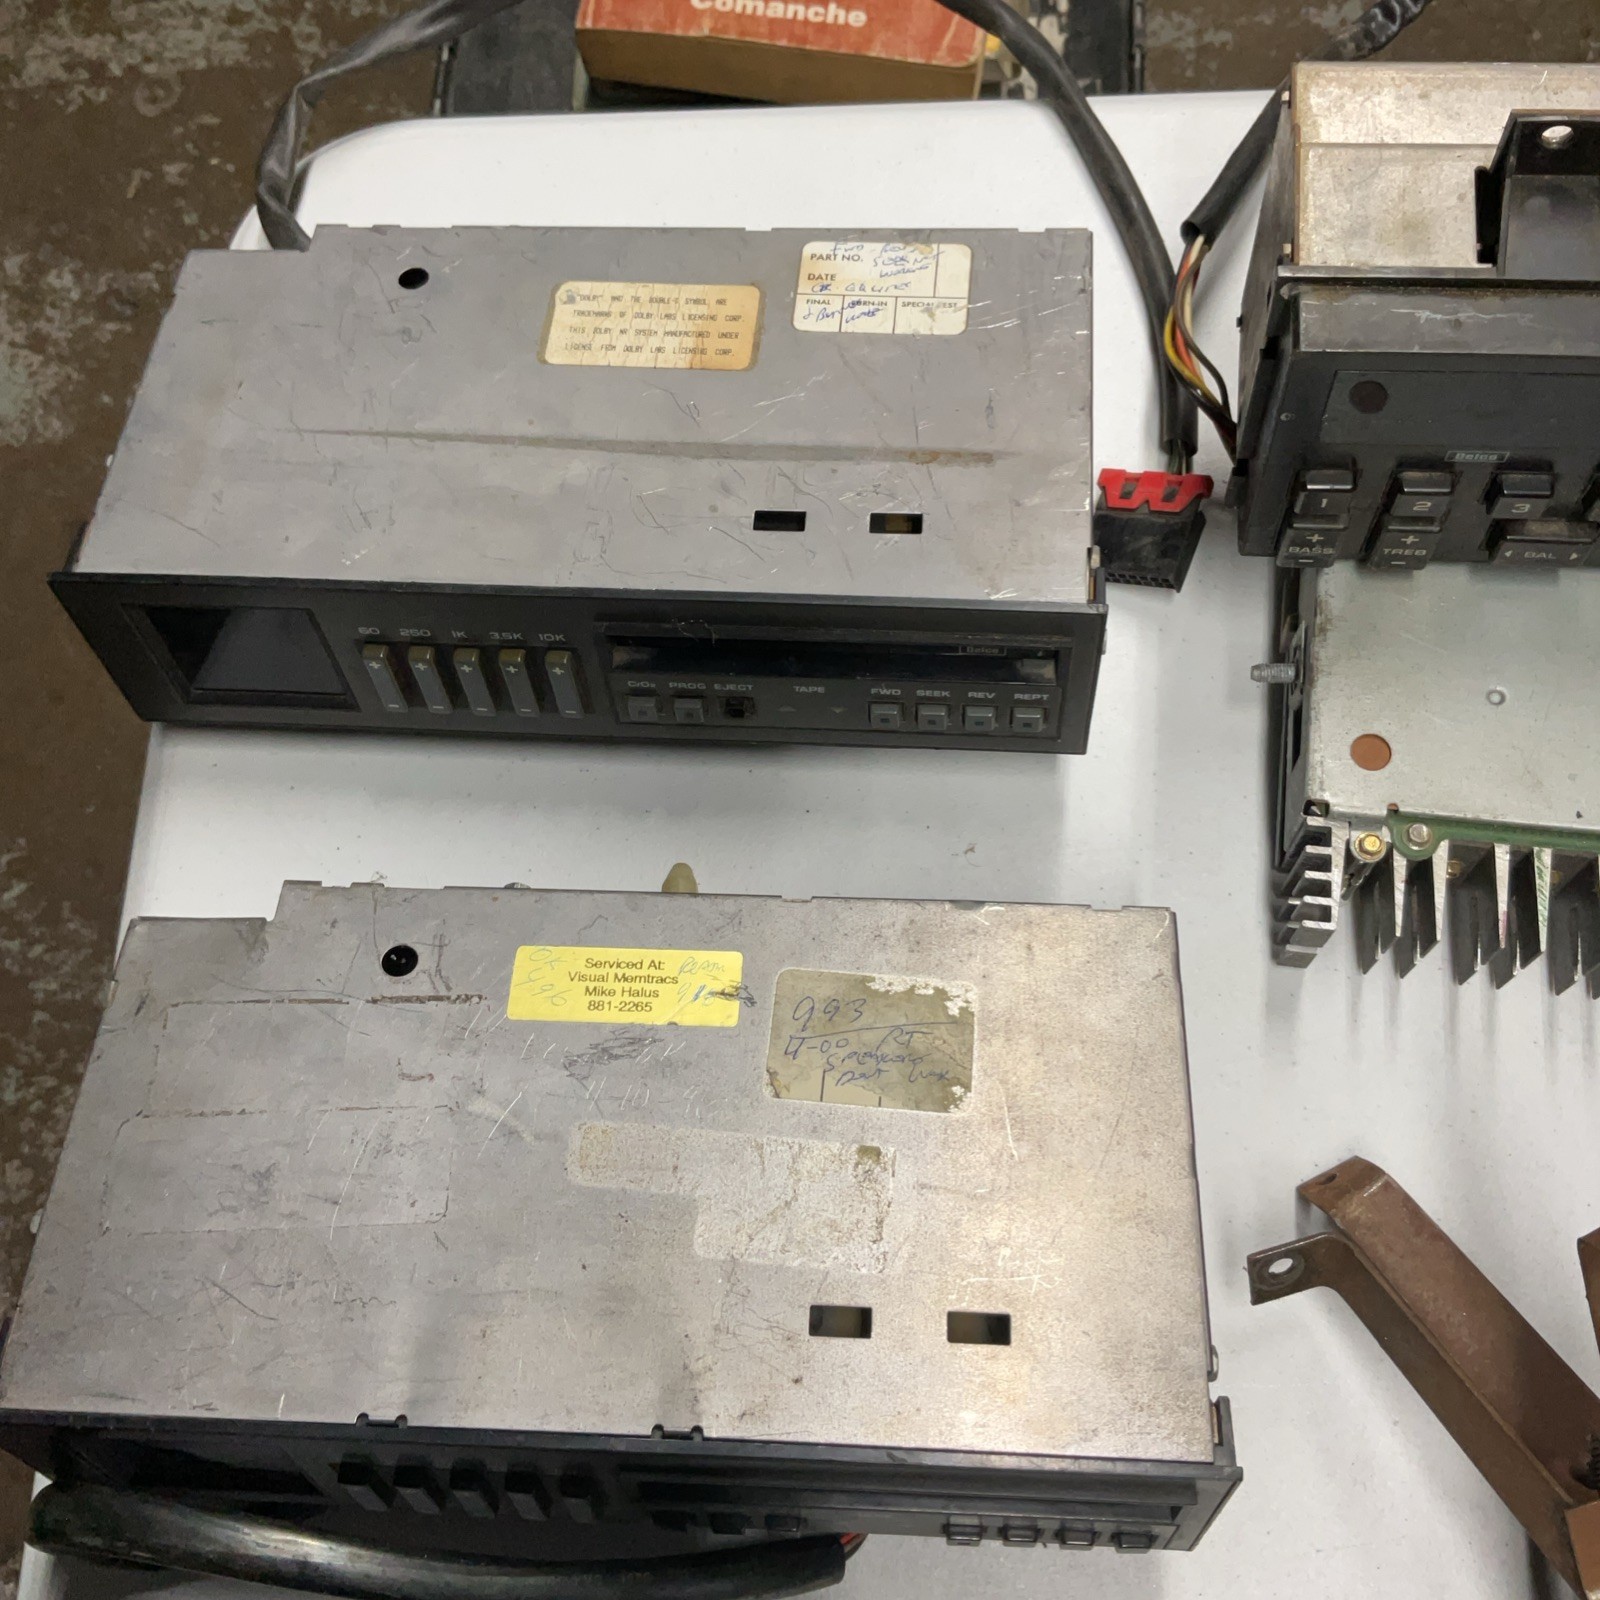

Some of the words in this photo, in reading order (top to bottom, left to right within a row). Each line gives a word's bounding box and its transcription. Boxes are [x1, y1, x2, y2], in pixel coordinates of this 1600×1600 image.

[810, 253, 838, 261] PART
[841, 254, 864, 262] NO.
[807, 273, 837, 281] DATE
[806, 298, 832, 306] FINAL
[660, 312, 677, 320] LABS
[682, 313, 718, 321] LICENSING
[569, 326, 586, 334] THIS
[593, 327, 612, 335] DOLBY
[634, 328, 658, 337] SYSTEM
[664, 330, 711, 338] MANUFACTURED
[717, 331, 740, 339] UNDER
[623, 344, 643, 353] DOLBY
[650, 346, 666, 354] LABS
[673, 347, 708, 355] LICENSING
[1320, 498, 1328, 508] 1
[1413, 501, 1432, 511] 2
[1511, 503, 1531, 513] 3
[1288, 546, 1333, 555] BASS
[1383, 548, 1427, 556] TREB
[1524, 551, 1556, 560] BAL
[400, 628, 432, 638] 250
[452, 630, 468, 639] 1K
[489, 631, 524, 641] 3.5K
[538, 633, 567, 642] 10K
[669, 682, 707, 690] PROG
[713, 683, 754, 692] EJECT
[793, 685, 826, 694] TAPE
[870, 688, 902, 696] FWD
[916, 689, 951, 698] SEEK
[968, 691, 996, 699] REV
[1014, 693, 1050, 701] REPT
[584, 957, 644, 971] Serviced
[648, 958, 666, 971] At:
[568, 971, 609, 983] Visual
[614, 972, 679, 985] Memtracs
[584, 986, 616, 998] Mike
[621, 987, 660, 999] Halus
[587, 999, 653, 1013] 881-2265
